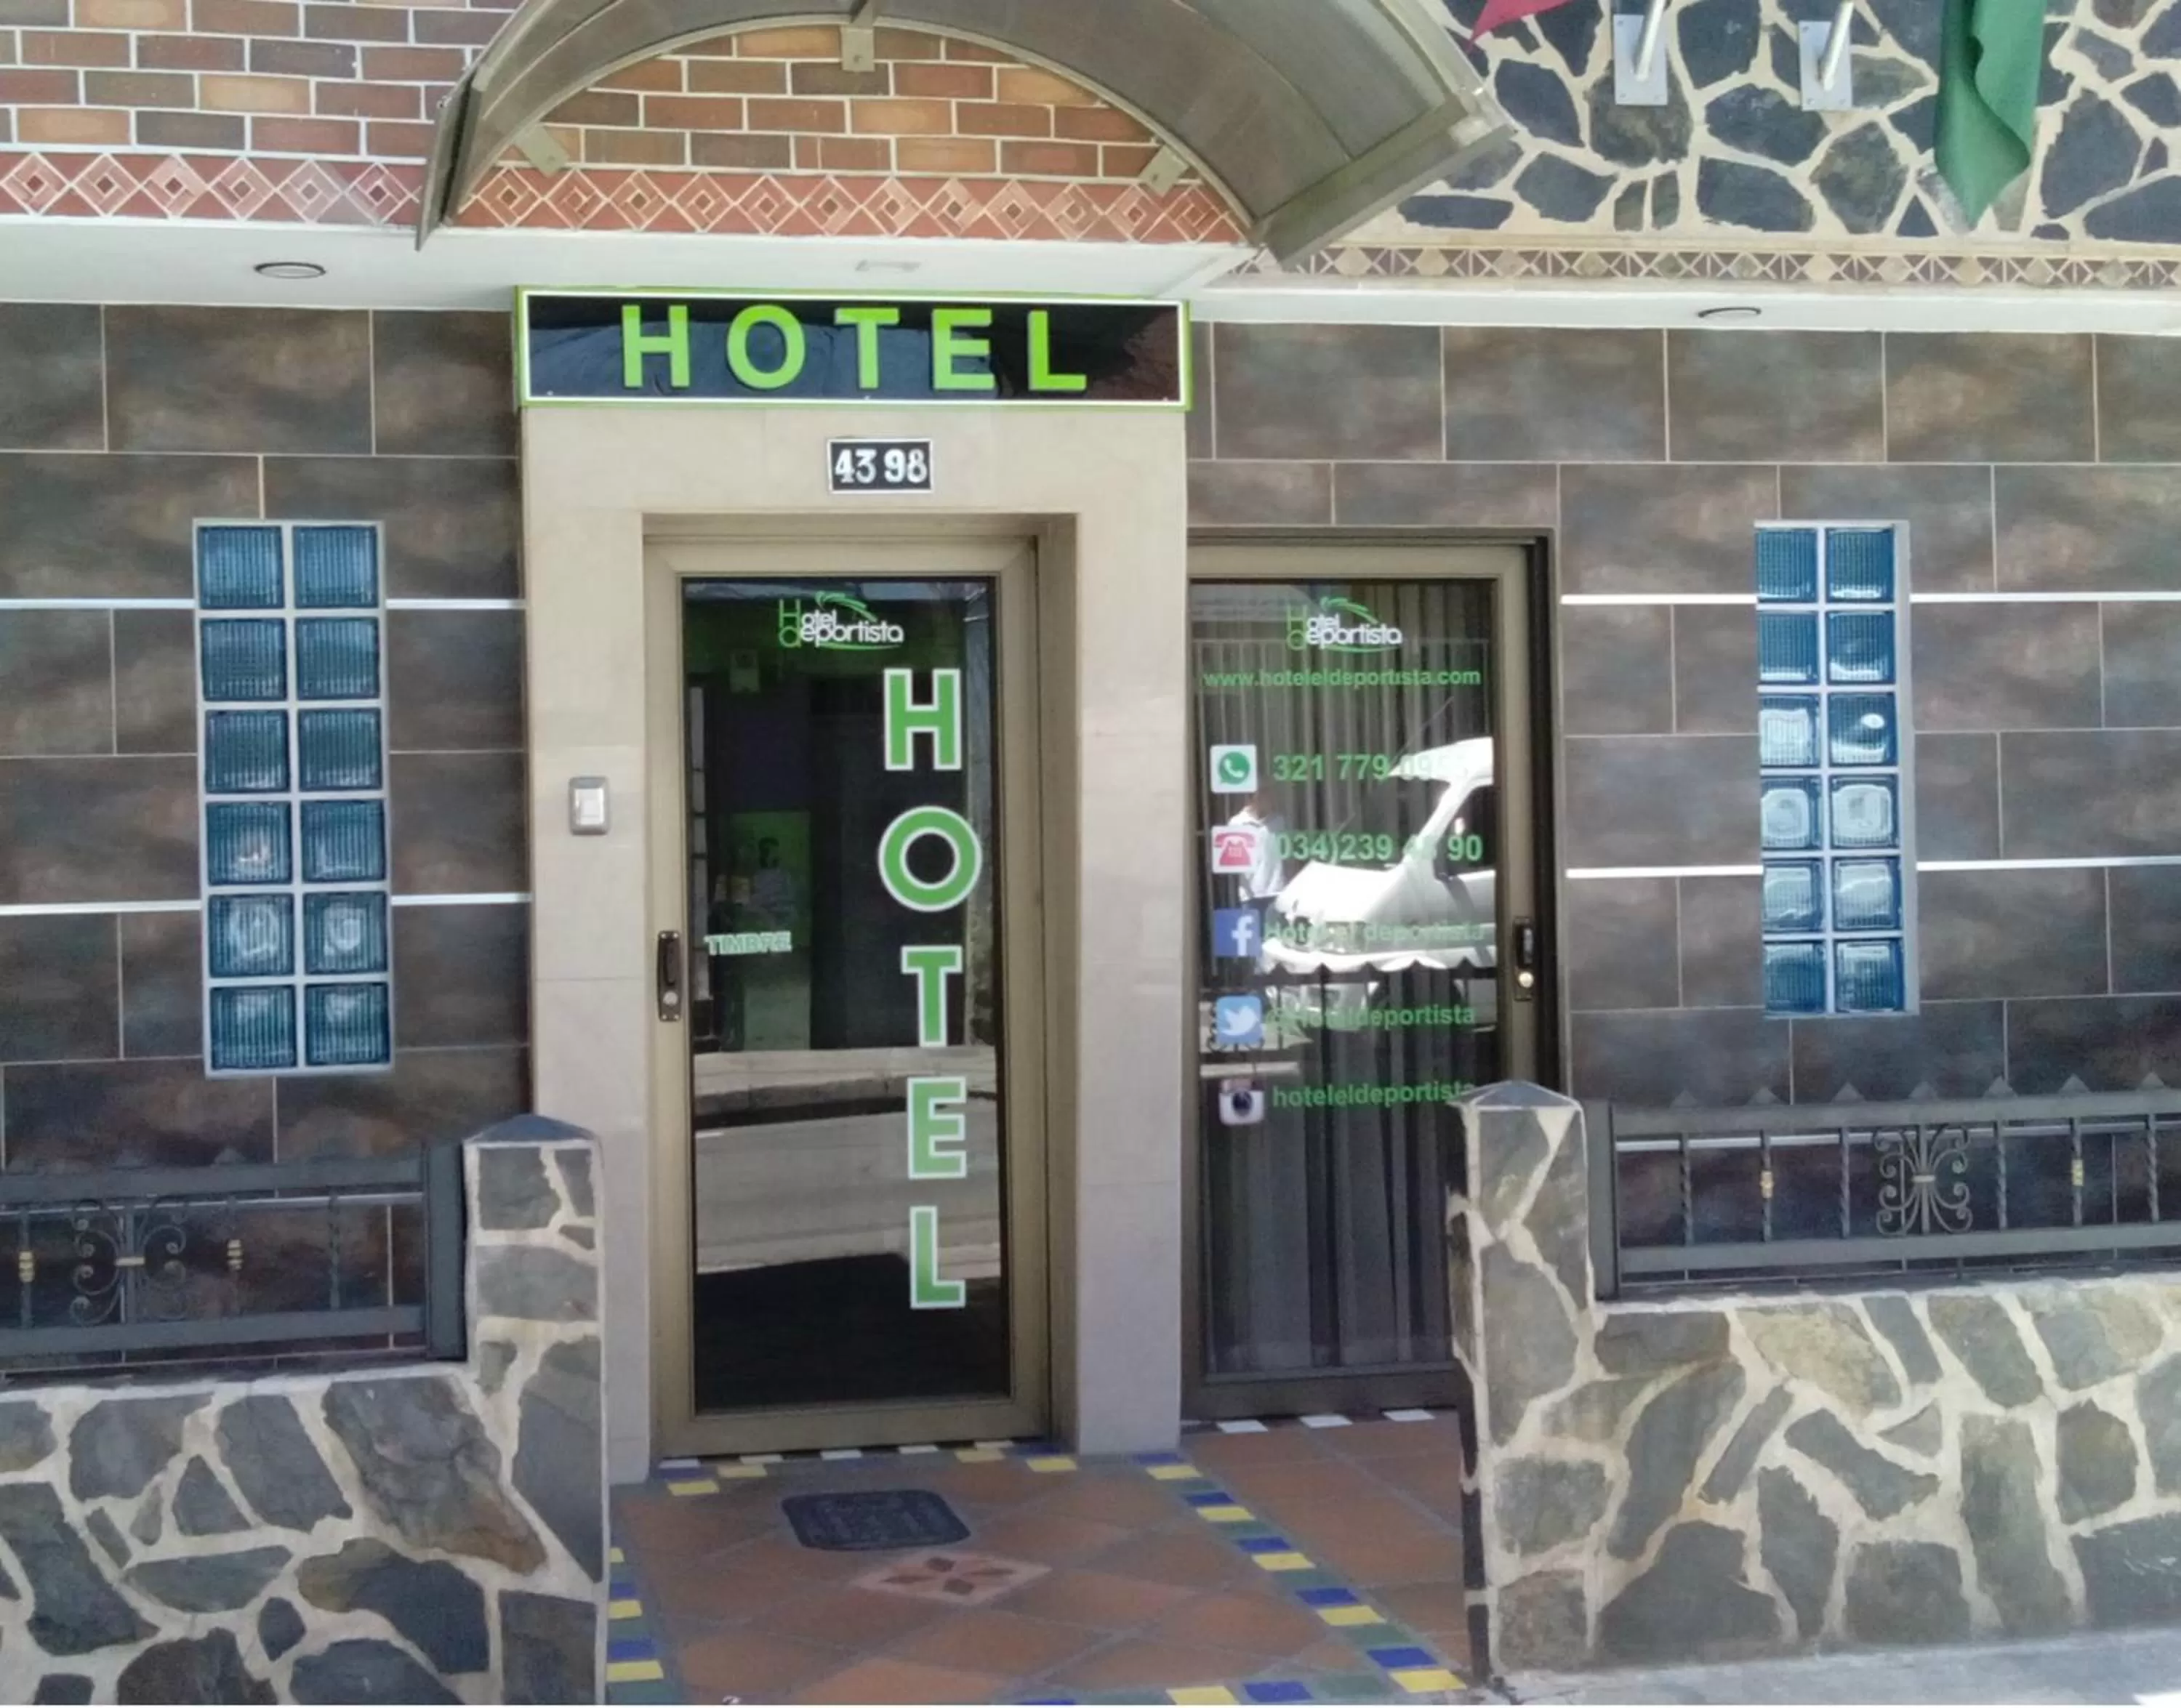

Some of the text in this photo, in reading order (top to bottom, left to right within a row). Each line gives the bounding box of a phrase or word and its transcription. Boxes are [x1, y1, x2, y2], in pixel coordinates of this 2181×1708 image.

[621, 304, 1088, 392] HOTEL
[835, 448, 928, 484] 43 98
[779, 598, 838, 629] Hotel
[1286, 604, 1341, 631] Hotel
[779, 620, 904, 648] deportista
[1286, 622, 1403, 650] deportista
[1203, 668, 1482, 690] www.hoteleldeportista.com
[1273, 754, 1325, 781] 321
[1337, 753, 1390, 781] 779
[1447, 834, 1483, 861] 90
[1231, 915, 1254, 956] f
[878, 667, 983, 1310] HOTEL
